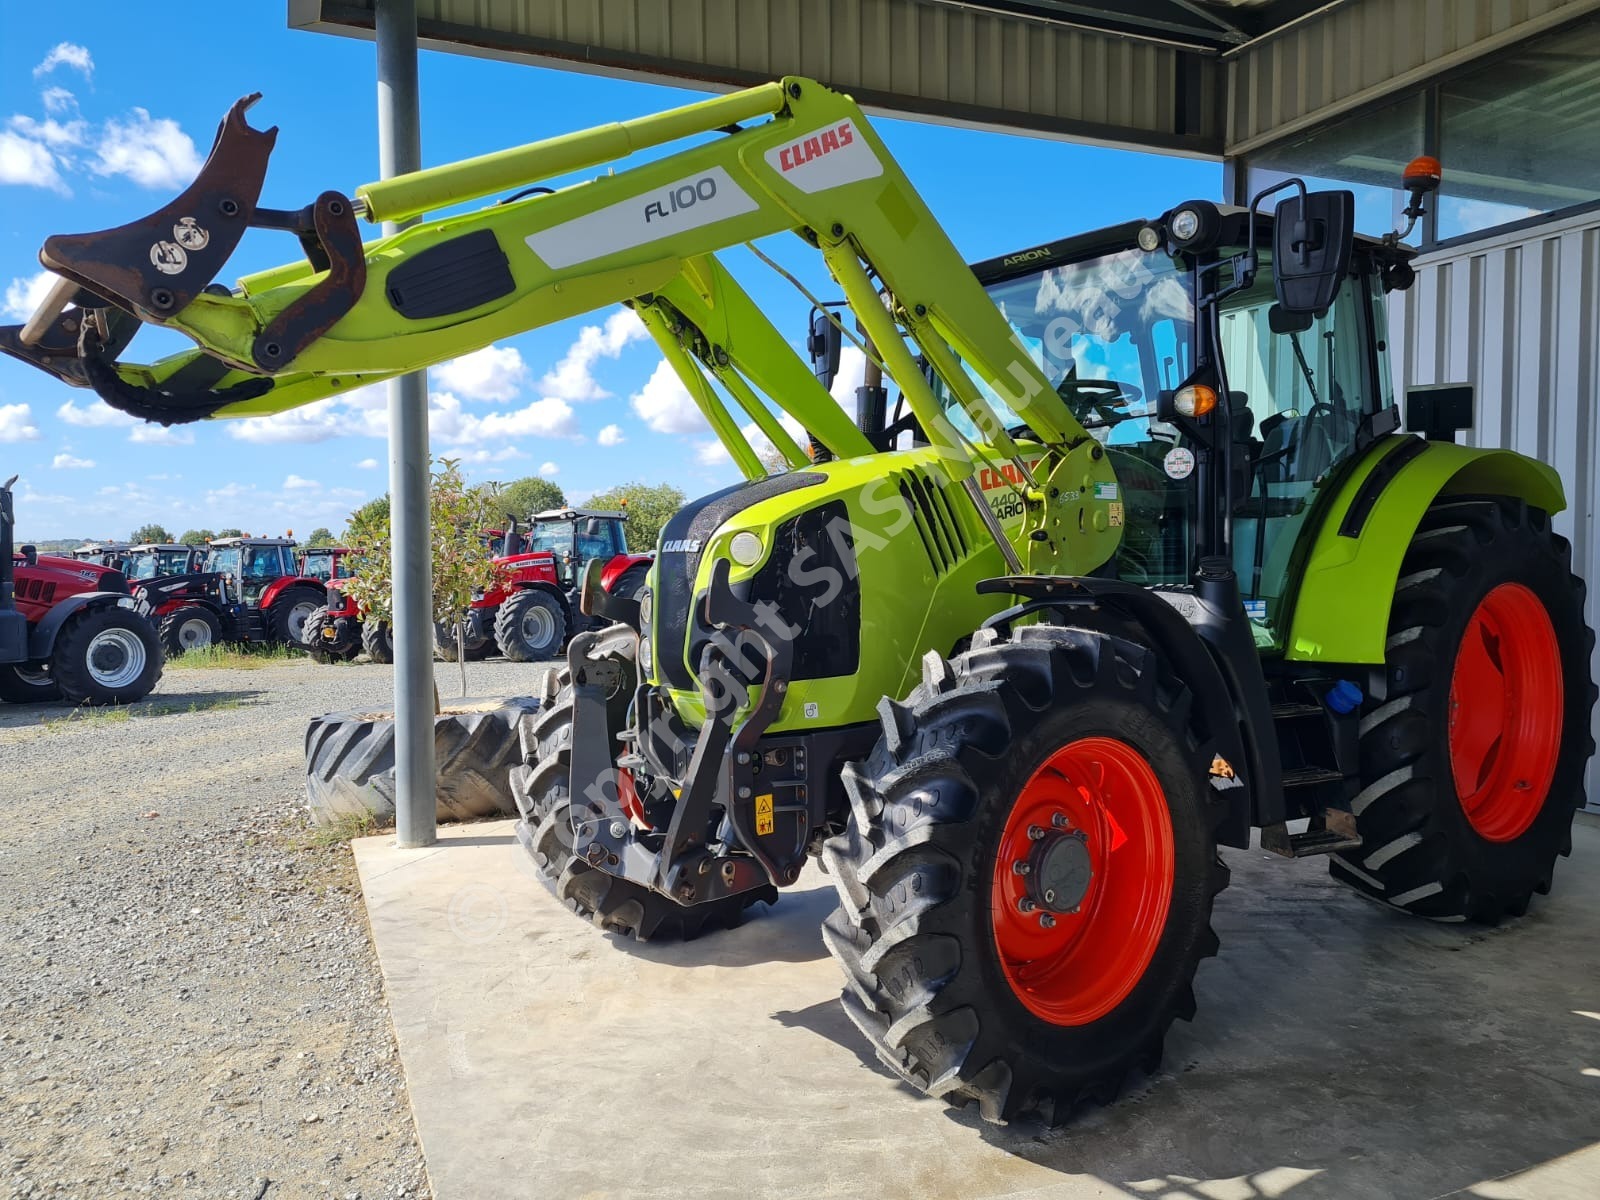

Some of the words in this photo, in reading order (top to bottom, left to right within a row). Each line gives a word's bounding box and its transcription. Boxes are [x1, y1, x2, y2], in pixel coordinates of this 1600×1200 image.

[779, 123, 854, 172] CLAAS
[1003, 247, 1052, 267] ARION
[990, 493, 1017, 509] 440
[997, 501, 1025, 520] ARIO
[661, 540, 701, 553] CLAAS
